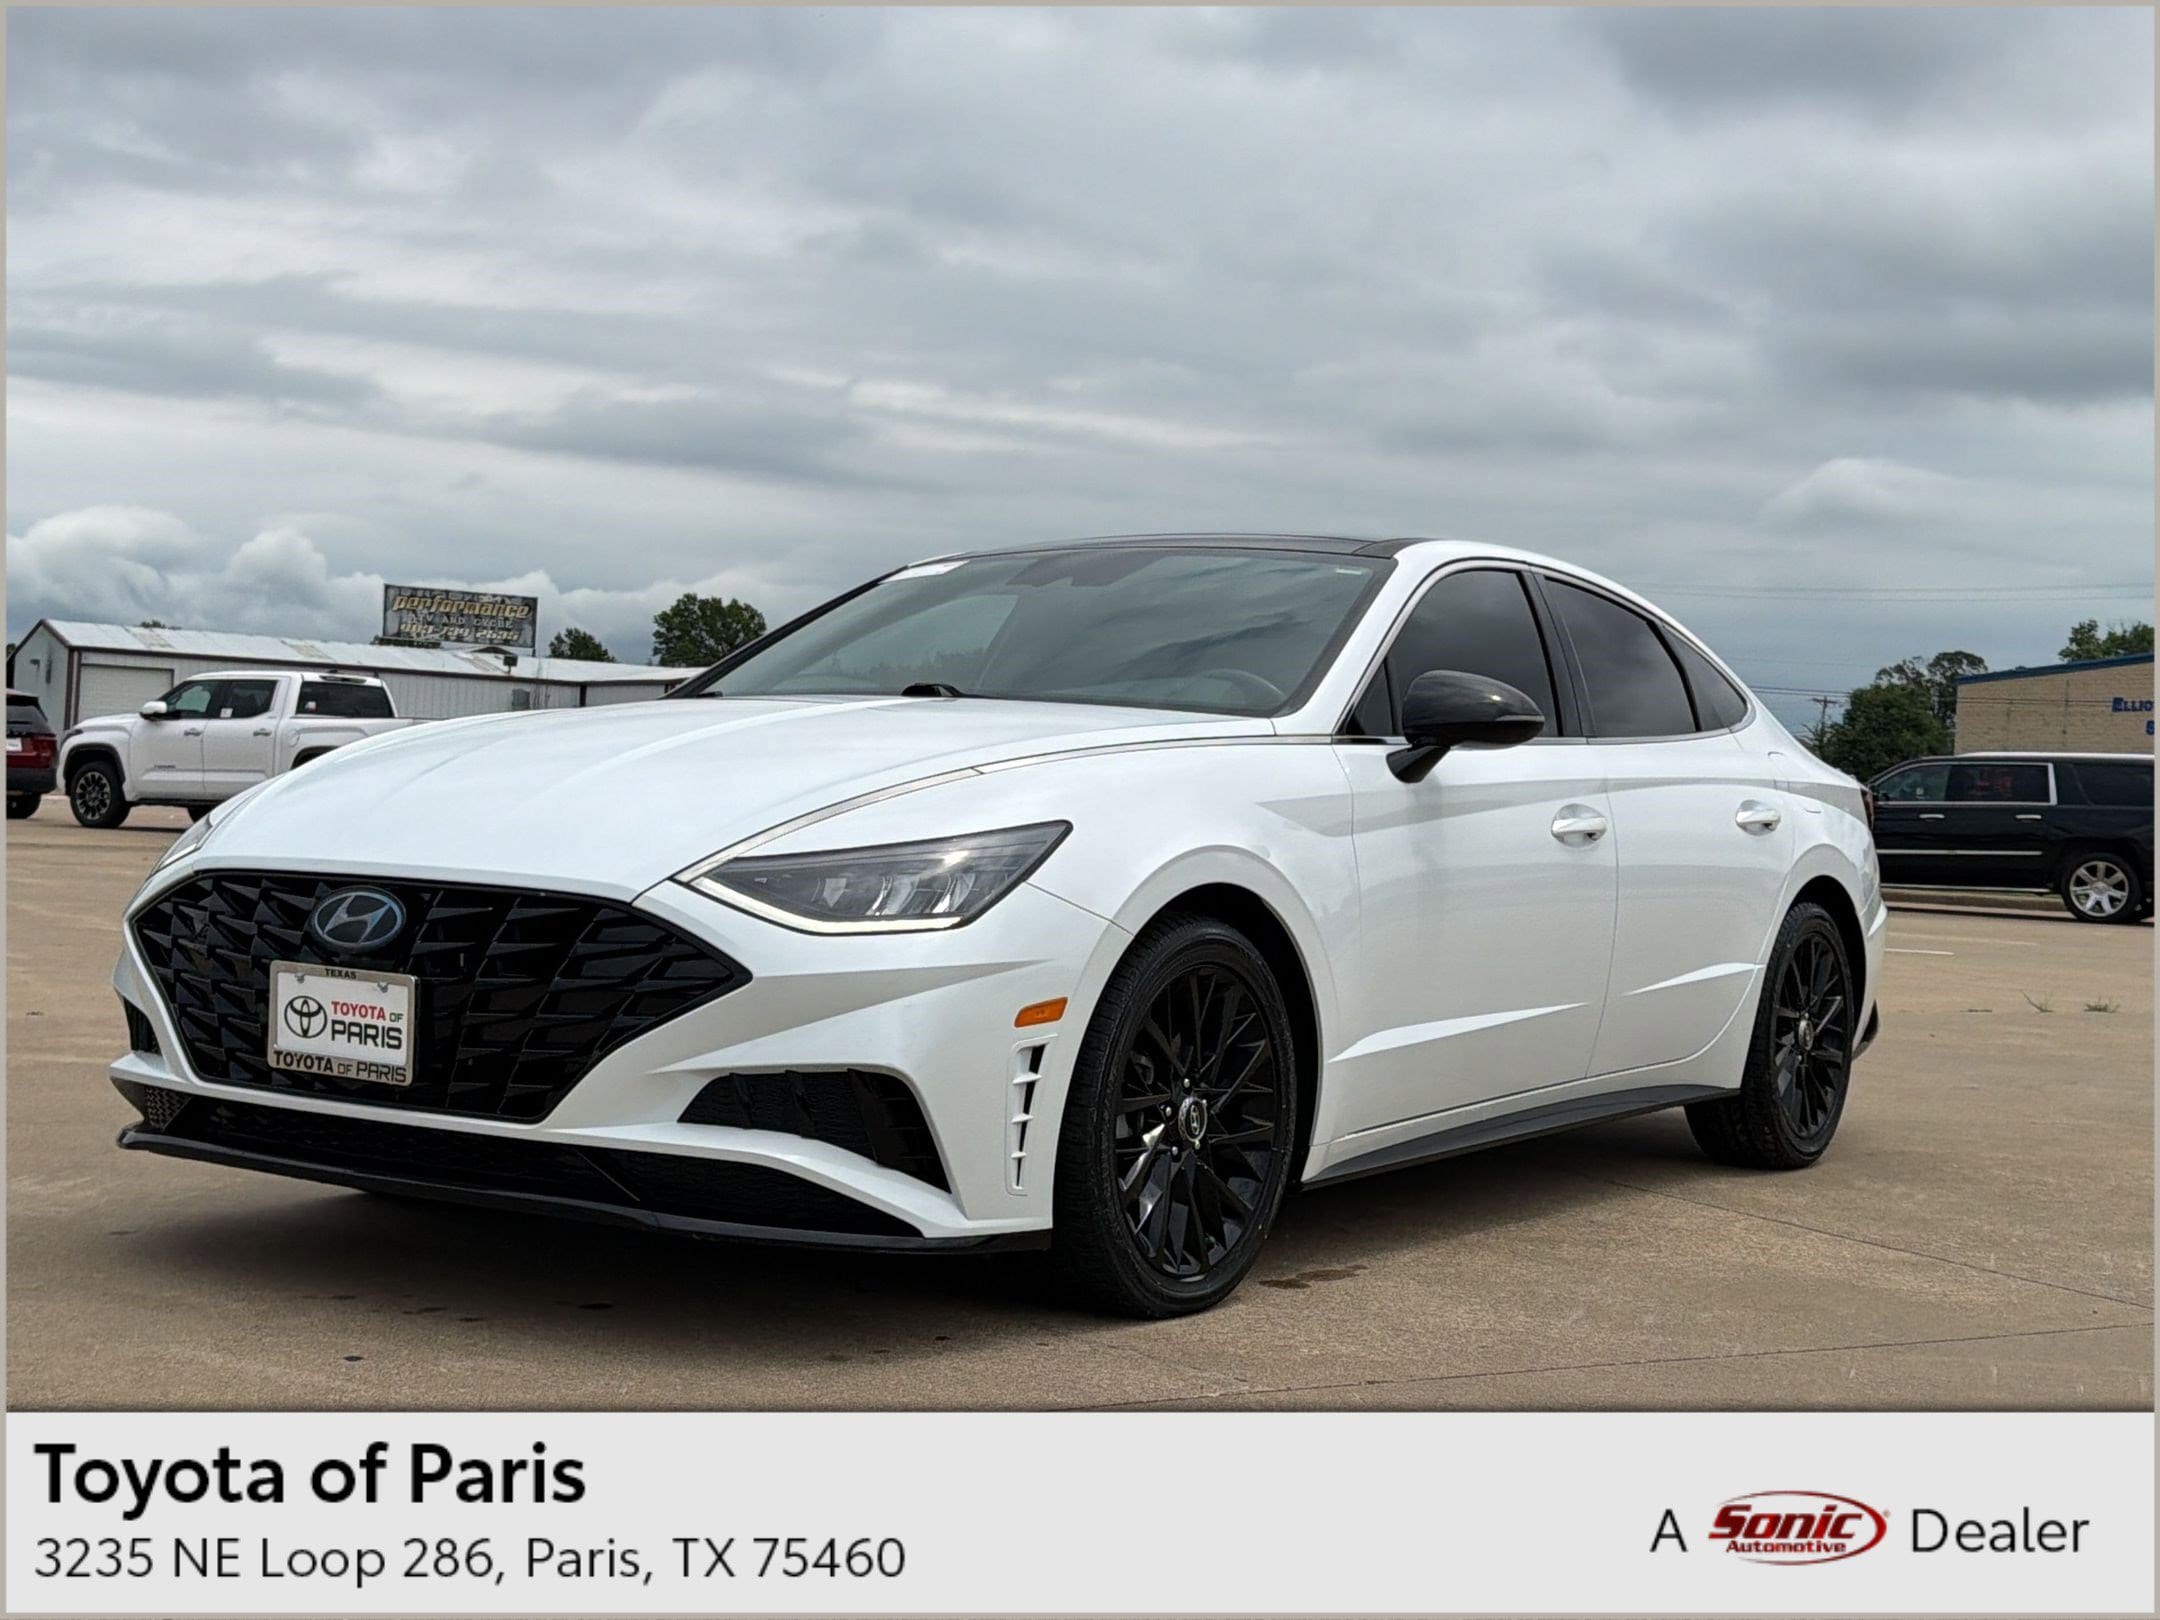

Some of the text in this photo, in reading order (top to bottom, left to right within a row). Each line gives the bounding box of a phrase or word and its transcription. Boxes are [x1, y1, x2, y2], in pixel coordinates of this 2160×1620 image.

[392, 595, 531, 618] performance
[442, 616, 466, 626] AND
[325, 968, 357, 979] TEXAS
[331, 1001, 403, 1023] TOYOTA OF
[331, 1019, 402, 1050] PARIS
[273, 1050, 407, 1083] TOYOTA OF PARIS
